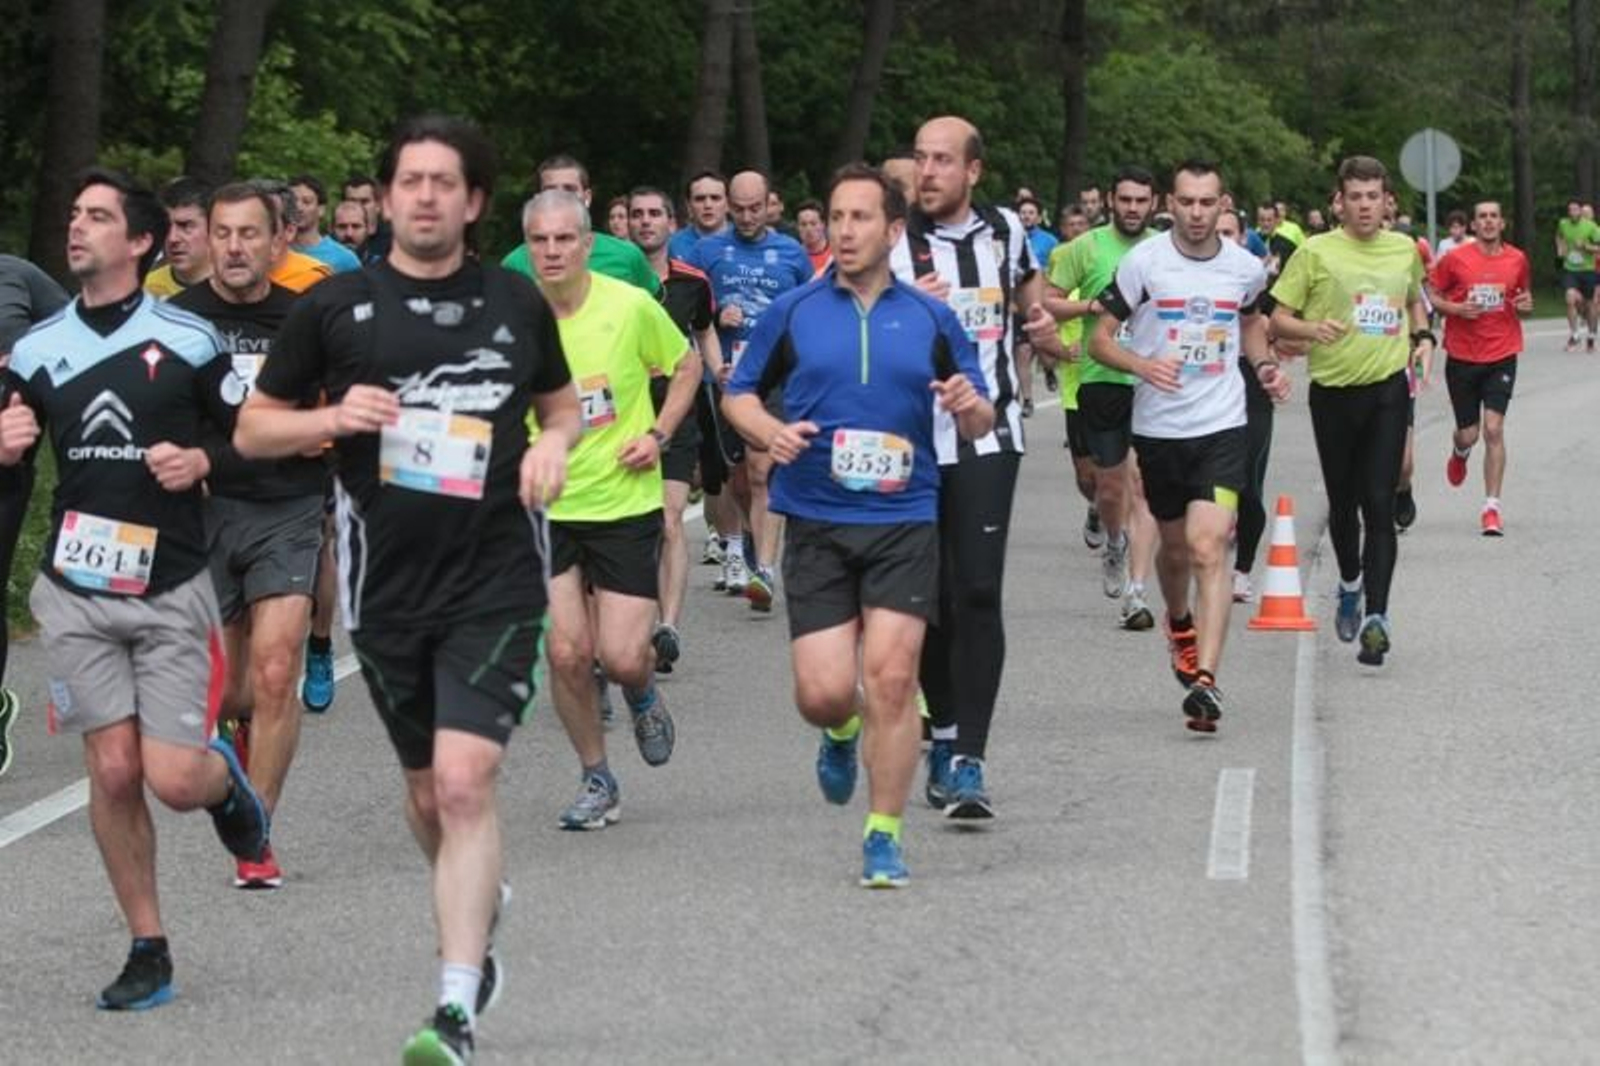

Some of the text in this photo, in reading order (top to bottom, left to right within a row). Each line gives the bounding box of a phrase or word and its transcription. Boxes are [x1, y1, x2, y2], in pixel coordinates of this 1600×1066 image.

[959, 305, 986, 328] 43
[1358, 309, 1393, 325] 290
[1180, 345, 1207, 361] 76
[412, 438, 433, 464] 8
[837, 451, 893, 476] 353
